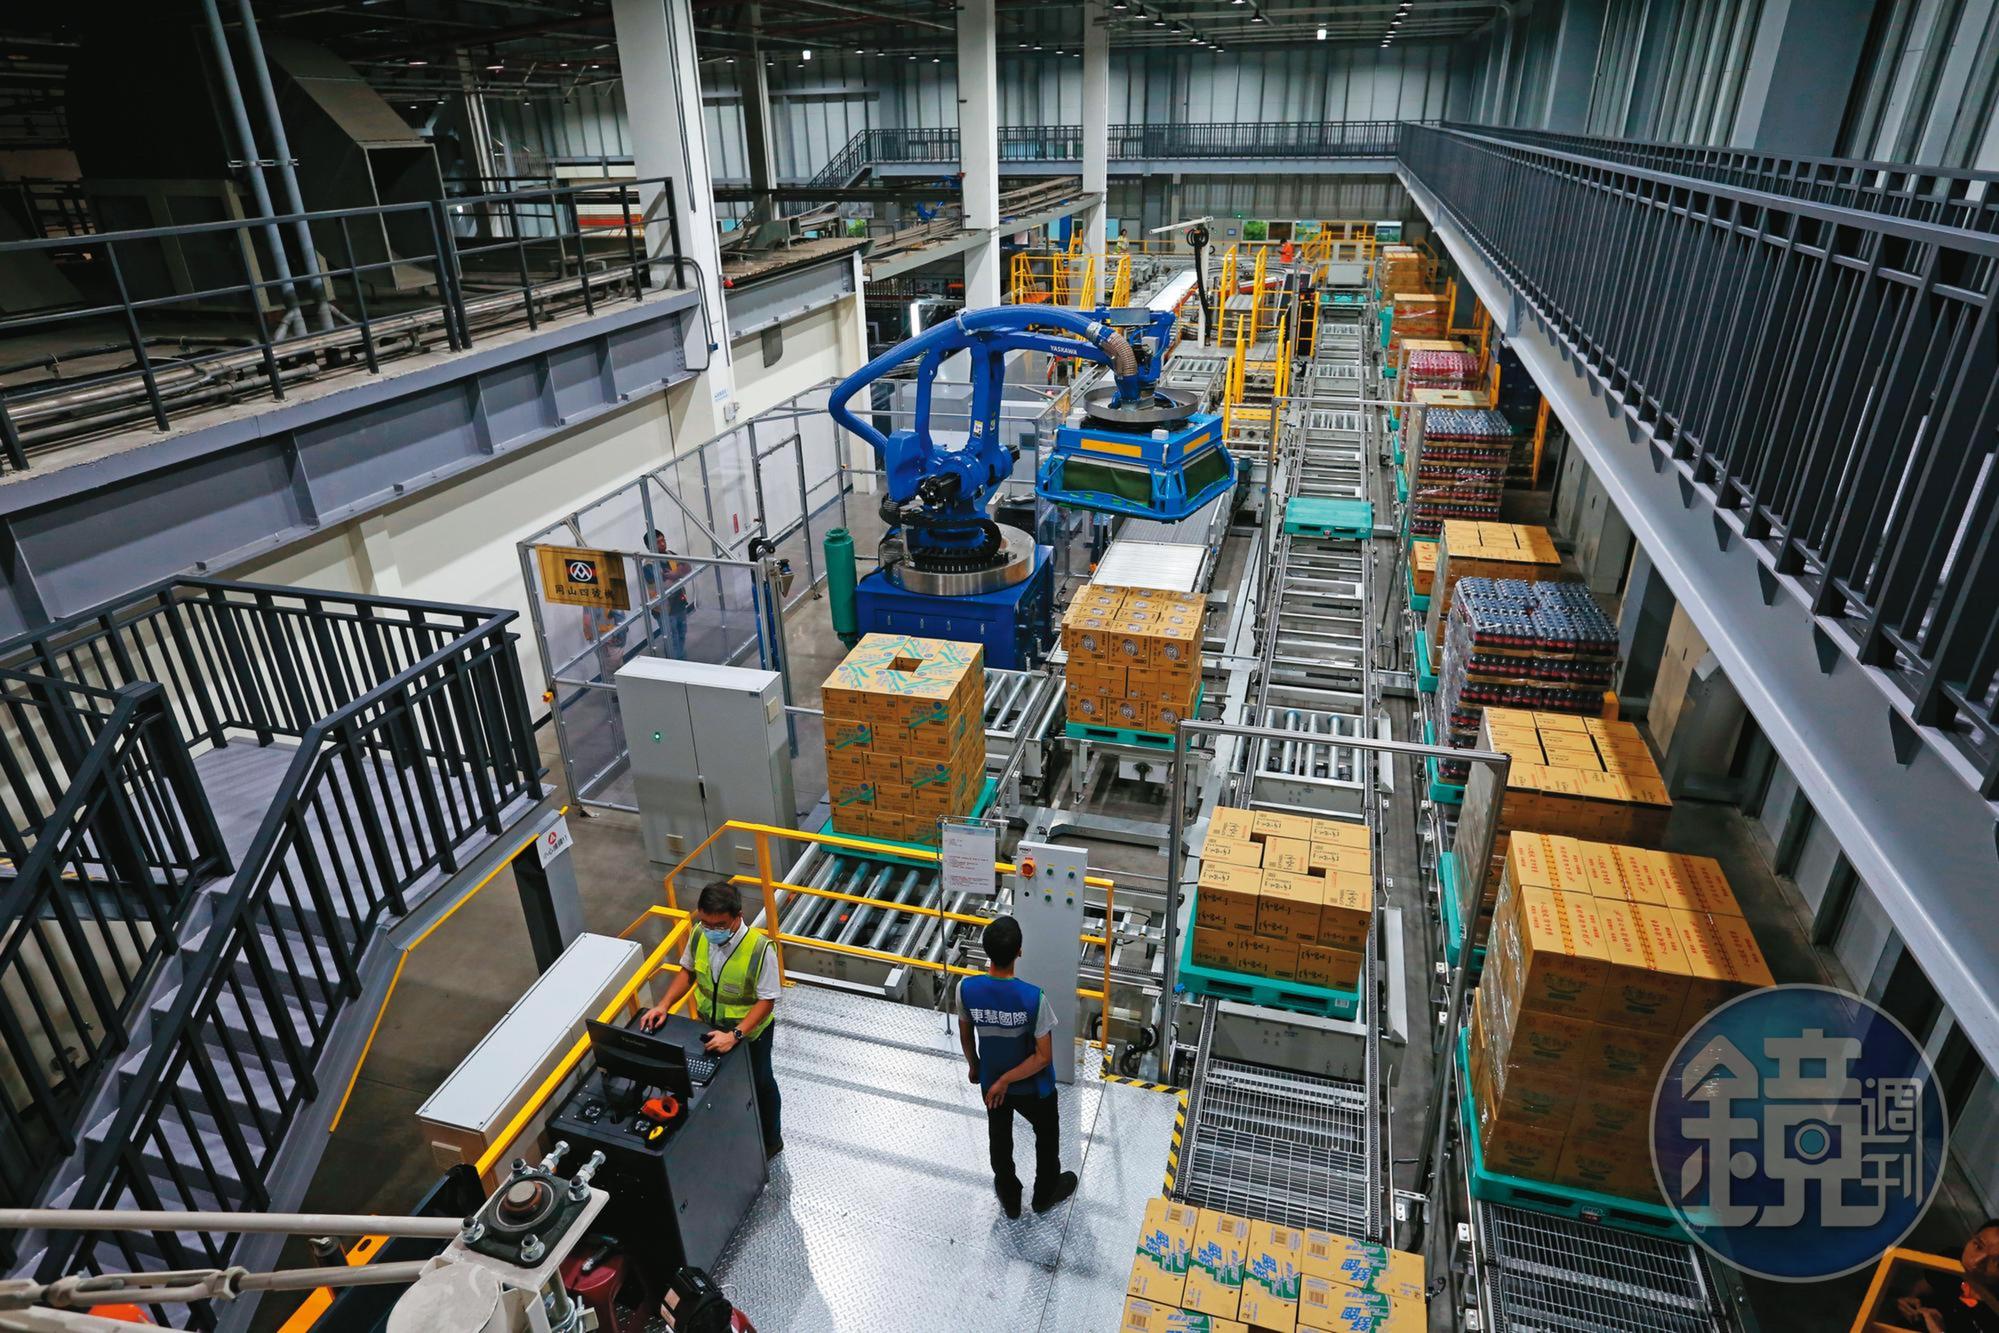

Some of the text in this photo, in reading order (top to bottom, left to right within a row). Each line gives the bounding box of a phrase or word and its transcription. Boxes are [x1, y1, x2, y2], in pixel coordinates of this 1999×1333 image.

[1050, 345, 1078, 355] YASKAWA
[969, 1008, 1029, 1026] 東慧國際
